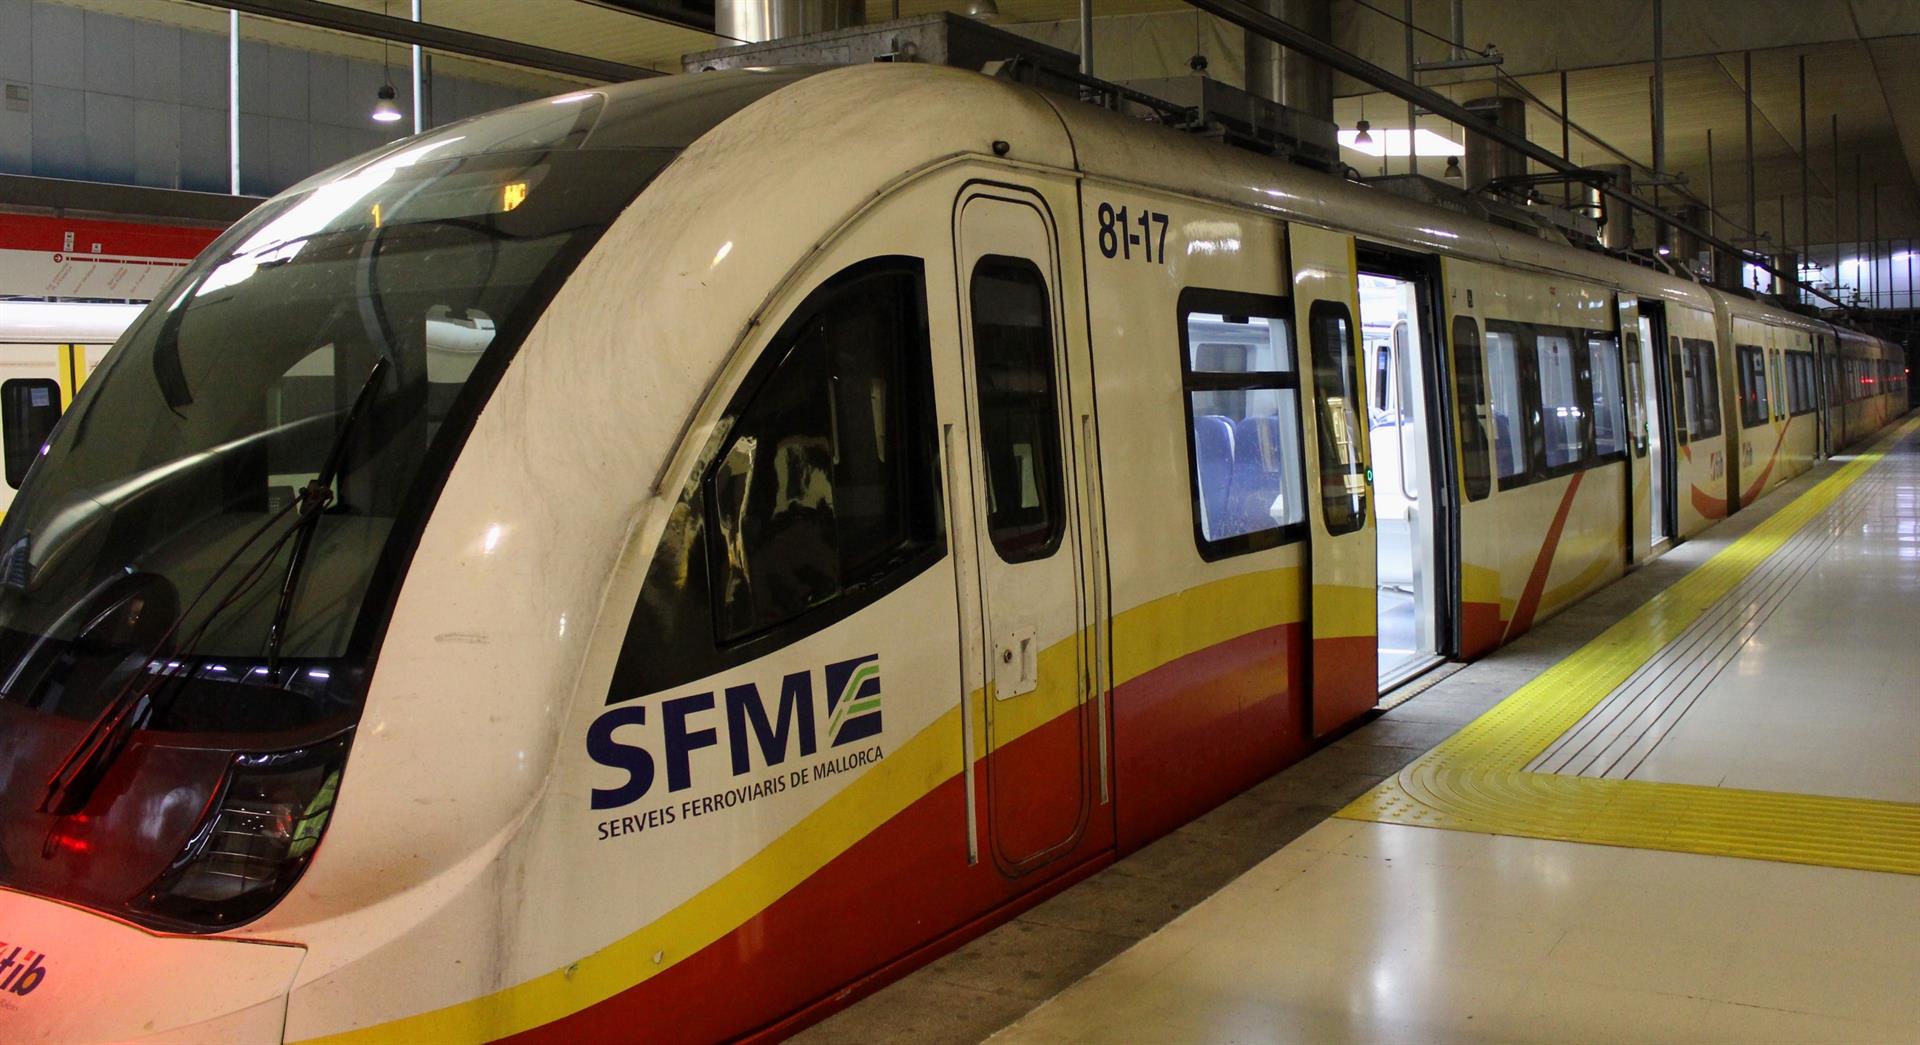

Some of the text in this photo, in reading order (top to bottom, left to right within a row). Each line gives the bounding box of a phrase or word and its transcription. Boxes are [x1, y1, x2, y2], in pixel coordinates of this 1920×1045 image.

[1098, 202, 1169, 264] 81-17
[586, 670, 817, 810] SFM
[597, 746, 884, 841] SERVEIS FERROVIARIS DE MALLORCA
